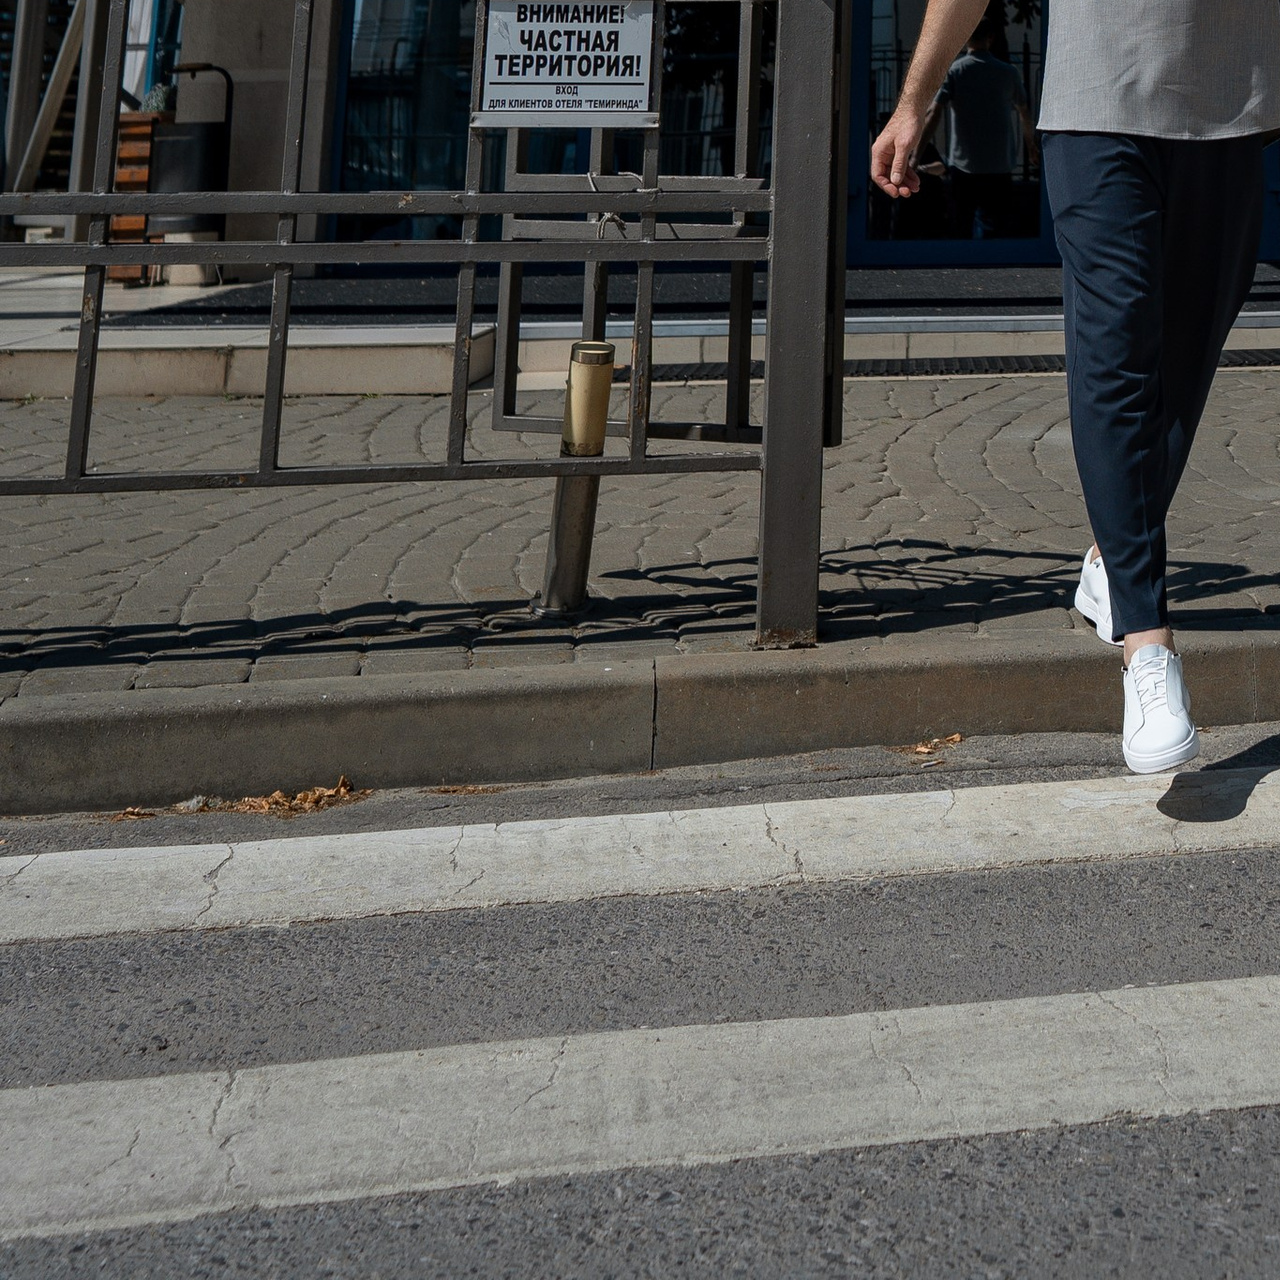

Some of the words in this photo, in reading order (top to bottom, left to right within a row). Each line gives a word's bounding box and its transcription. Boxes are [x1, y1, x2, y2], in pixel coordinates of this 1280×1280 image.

[516, 4, 625, 23] ВНИМАНИЕ!
[519, 29, 620, 52] ЧАСТНАЯ
[494, 54, 641, 77] ТЕРРИТОРИЯ!
[555, 85, 579, 96] ВХОД
[488, 99, 506, 109] ДЛЯ
[508, 99, 553, 109] КЛИЕНТОВ
[555, 99, 582, 109] ОТЕЛЯ
[584, 99, 643, 110] "ТЕМИРИНДА"
